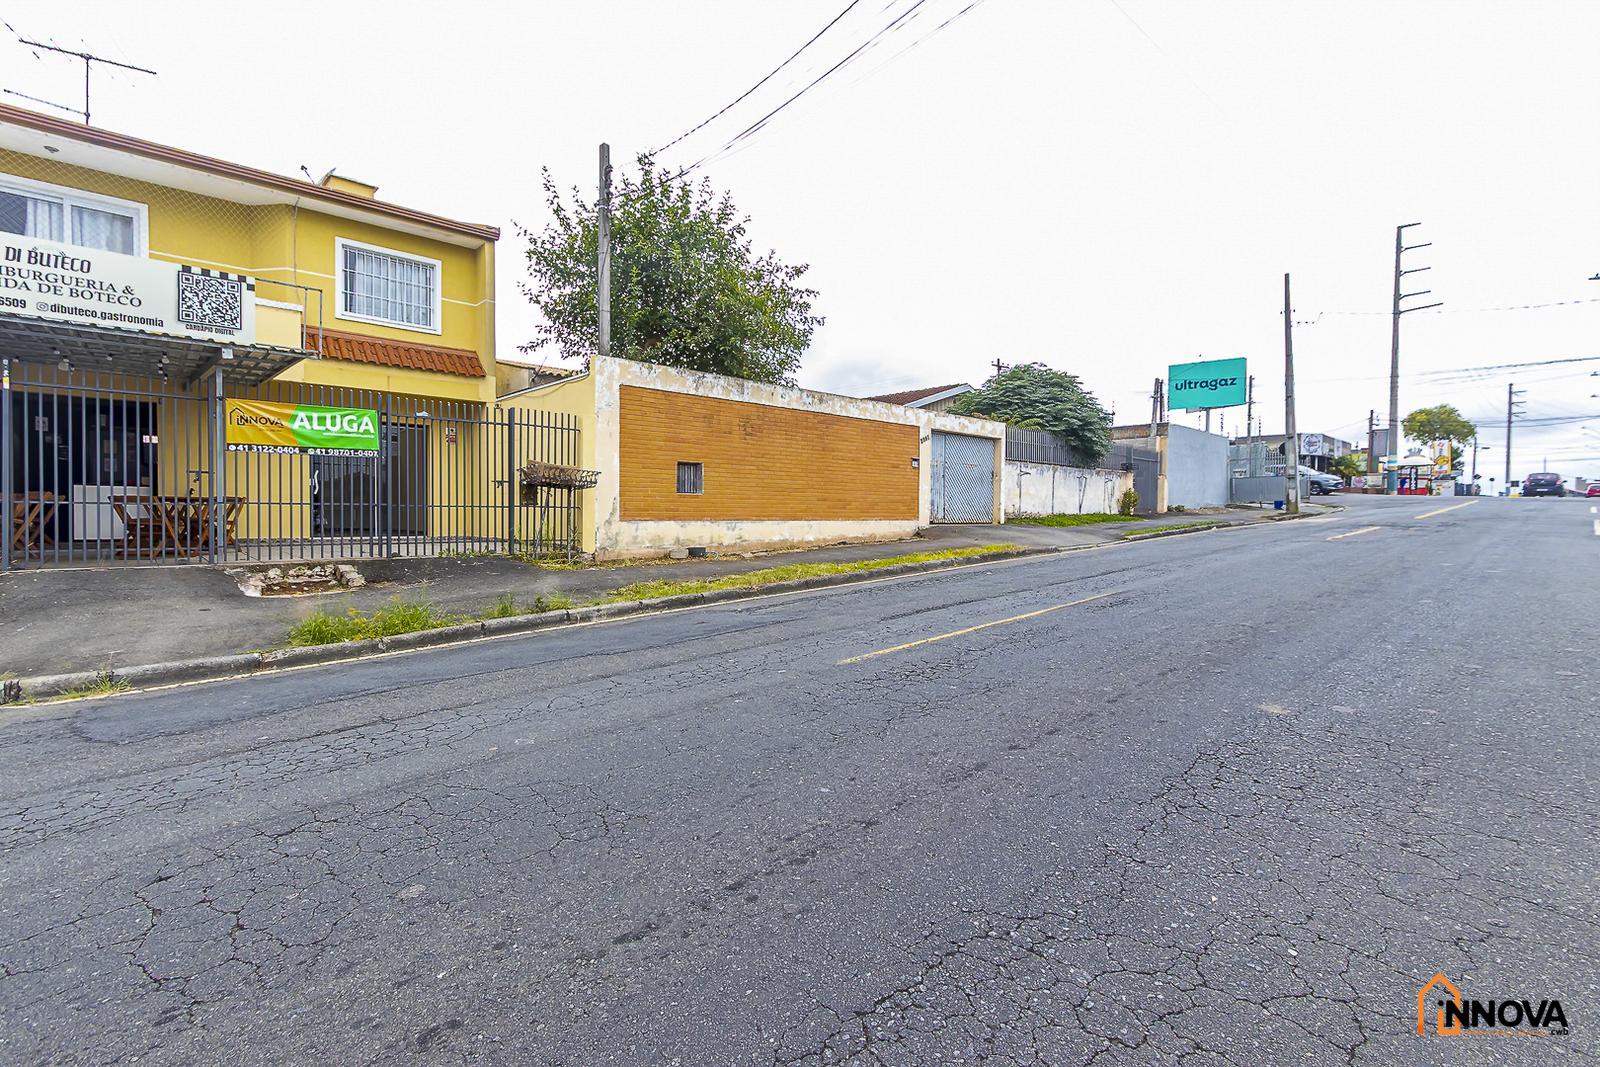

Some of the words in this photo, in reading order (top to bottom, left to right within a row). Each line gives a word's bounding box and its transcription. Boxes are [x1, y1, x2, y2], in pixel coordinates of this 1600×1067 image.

[5, 246, 21, 262] DI
[0, 265, 117, 293] BURGUERIA
[122, 285, 135, 296] &
[37, 282, 63, 296] DE
[69, 287, 142, 307] BOTECO
[214, 327, 235, 336] DIGITAL
[1175, 377, 1237, 391] ultragaz
[293, 411, 375, 434] ALUGA
[237, 444, 248, 452] 41
[251, 444, 300, 454] 3122-0404
